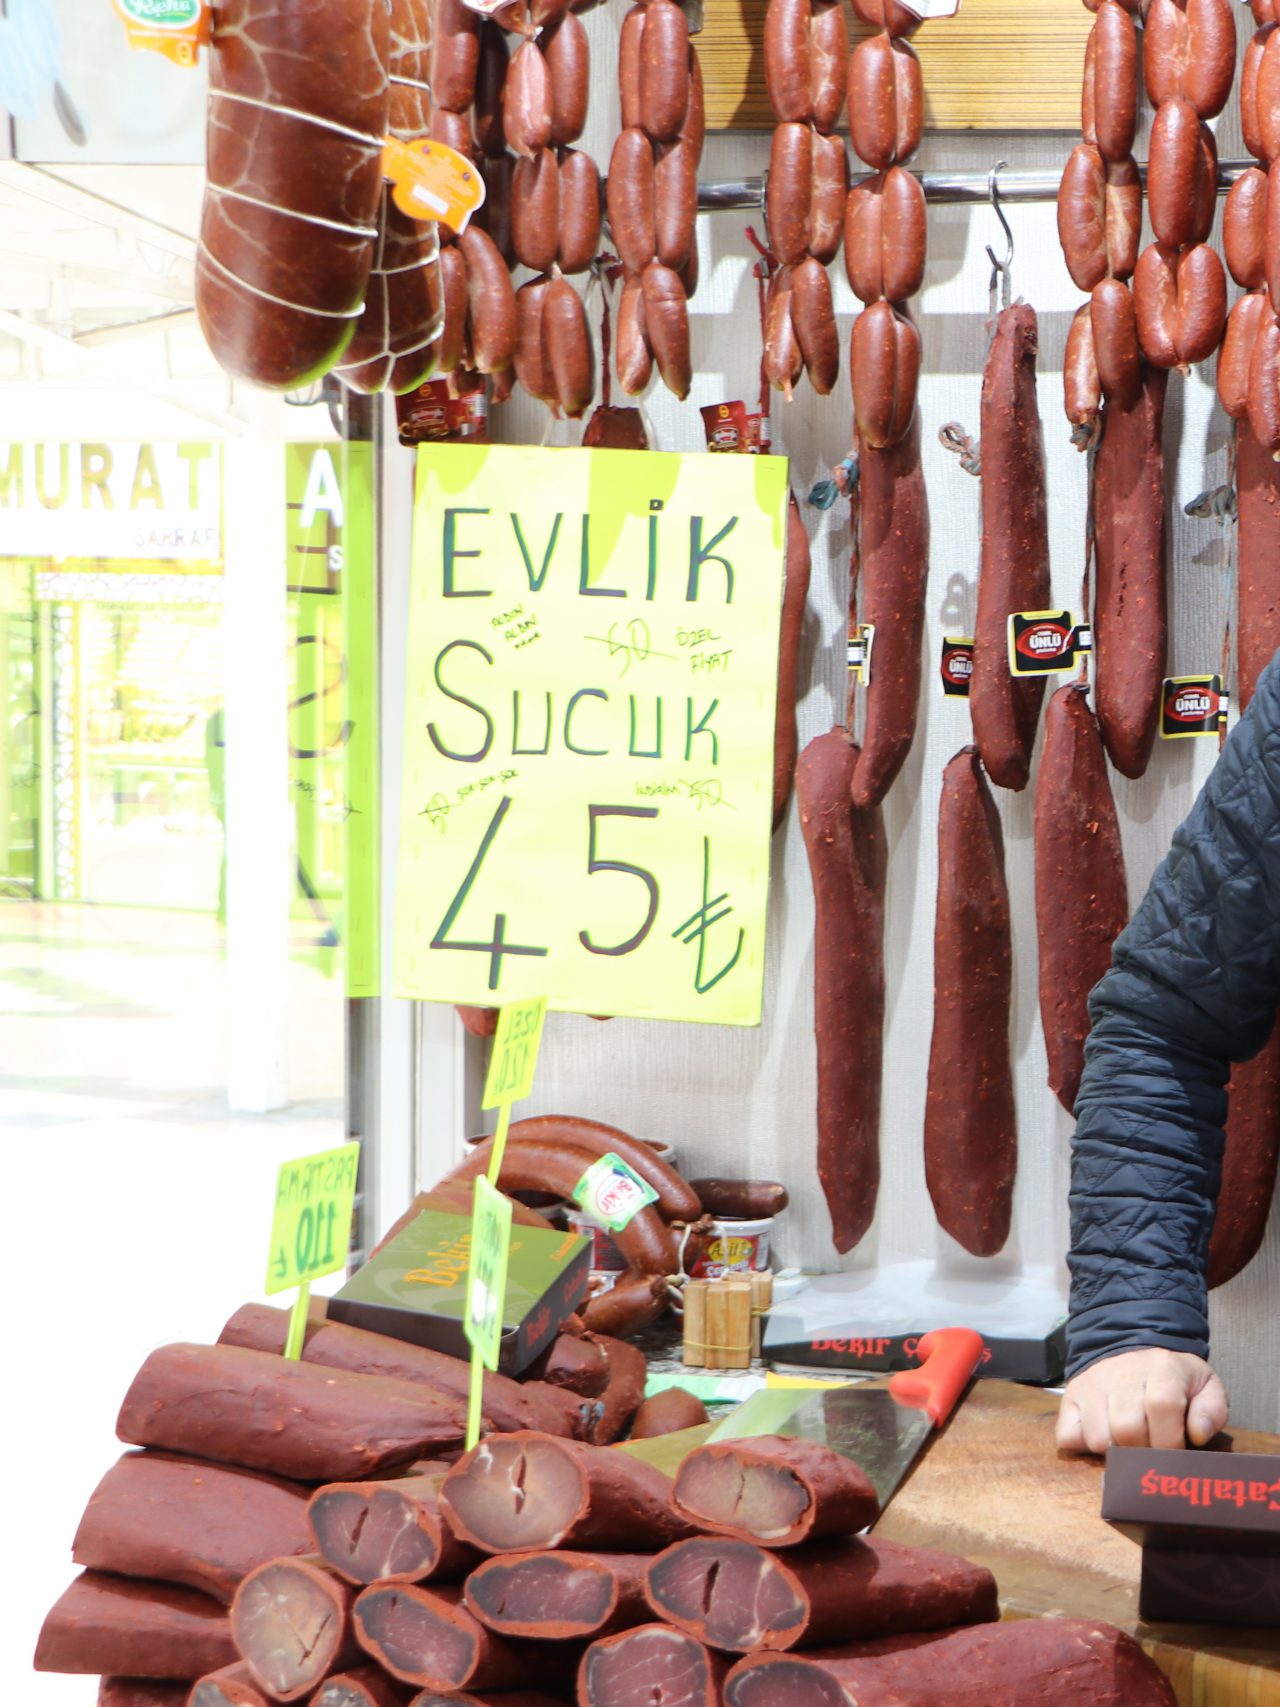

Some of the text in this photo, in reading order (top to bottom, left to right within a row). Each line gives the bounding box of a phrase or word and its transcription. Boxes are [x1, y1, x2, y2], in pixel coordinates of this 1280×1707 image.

[443, 498, 739, 604] EVLİK
[1029, 631, 1062, 649] ÜNLÜ
[426, 638, 719, 766] SUCUK
[1175, 695, 1211, 712] ÜNLÜ
